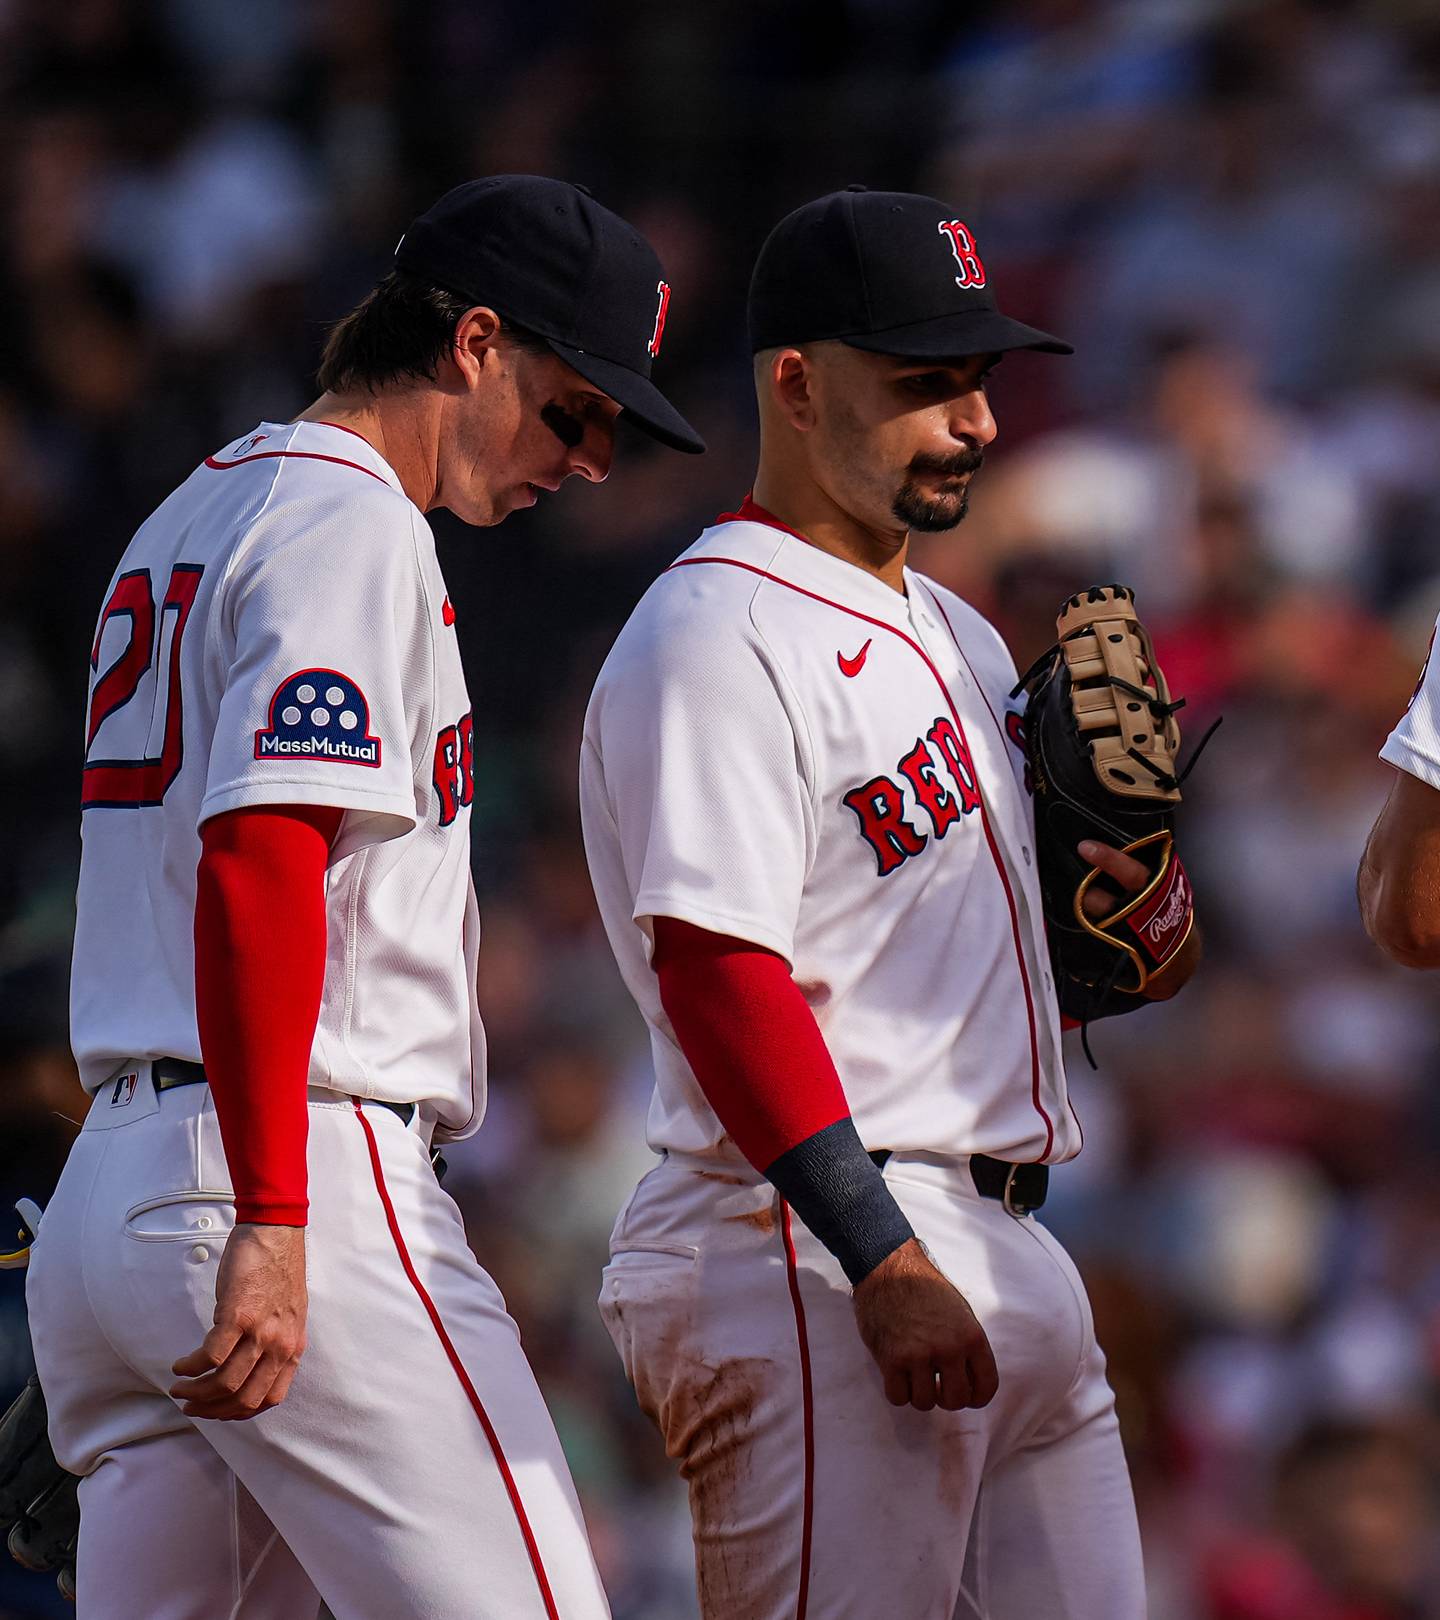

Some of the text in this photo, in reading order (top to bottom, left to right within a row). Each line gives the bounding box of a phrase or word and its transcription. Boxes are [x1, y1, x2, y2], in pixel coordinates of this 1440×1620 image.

[937, 219, 986, 290] B
[261, 735, 376, 760] MassMutual
[842, 716, 982, 877] RED
